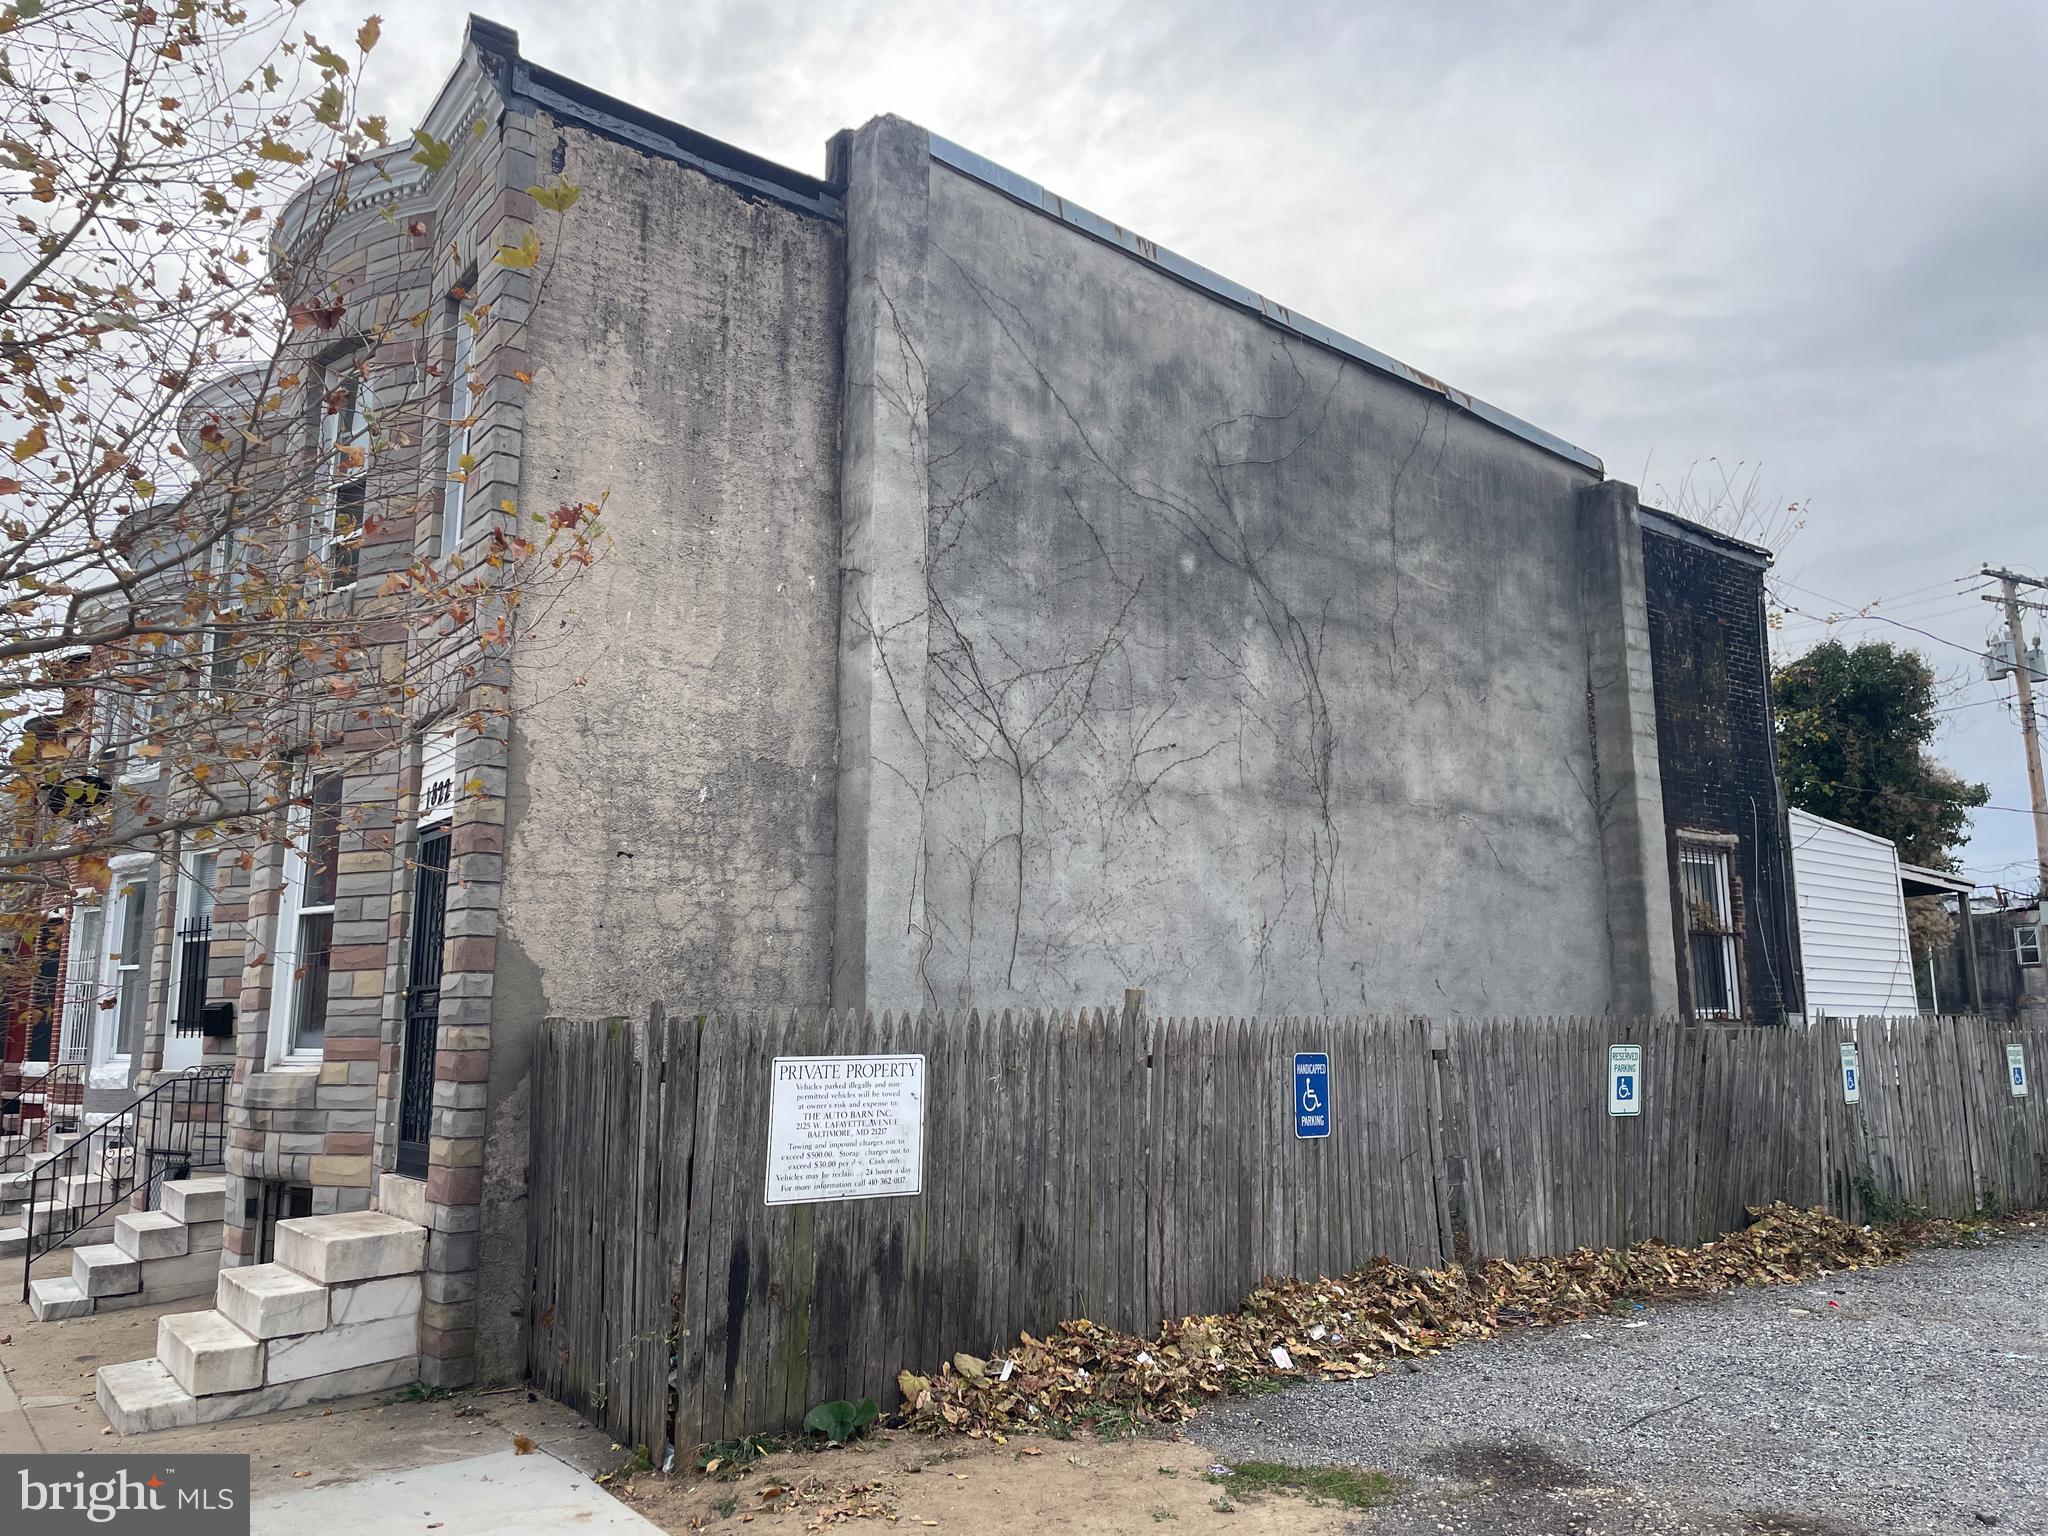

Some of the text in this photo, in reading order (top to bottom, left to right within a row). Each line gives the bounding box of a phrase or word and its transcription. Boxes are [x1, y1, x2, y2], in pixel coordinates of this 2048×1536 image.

[426, 778, 451, 809] 1822
[1613, 1052, 1638, 1060] RESERVED
[780, 1062, 917, 1080] PRIVATE PROPERTY
[1297, 1064, 1326, 1074] HANDICAPPED
[1614, 1064, 1636, 1072] PARKING
[825, 1082, 846, 1091] parked
[849, 1081, 872, 1089] illegally
[797, 1093, 828, 1101] permitted
[823, 1111, 848, 1119] AUTO
[851, 1110, 873, 1118] BARN
[1301, 1115, 1324, 1126] PARKING
[807, 1130, 854, 1138] BALTIMORE,
[829, 1140, 857, 1149] impound
[860, 1139, 883, 1147] charges
[865, 1148, 888, 1156] charges
[788, 1162, 811, 1170] exceed
[776, 1173, 803, 1181] Vehicles
[814, 1181, 852, 1190] information
